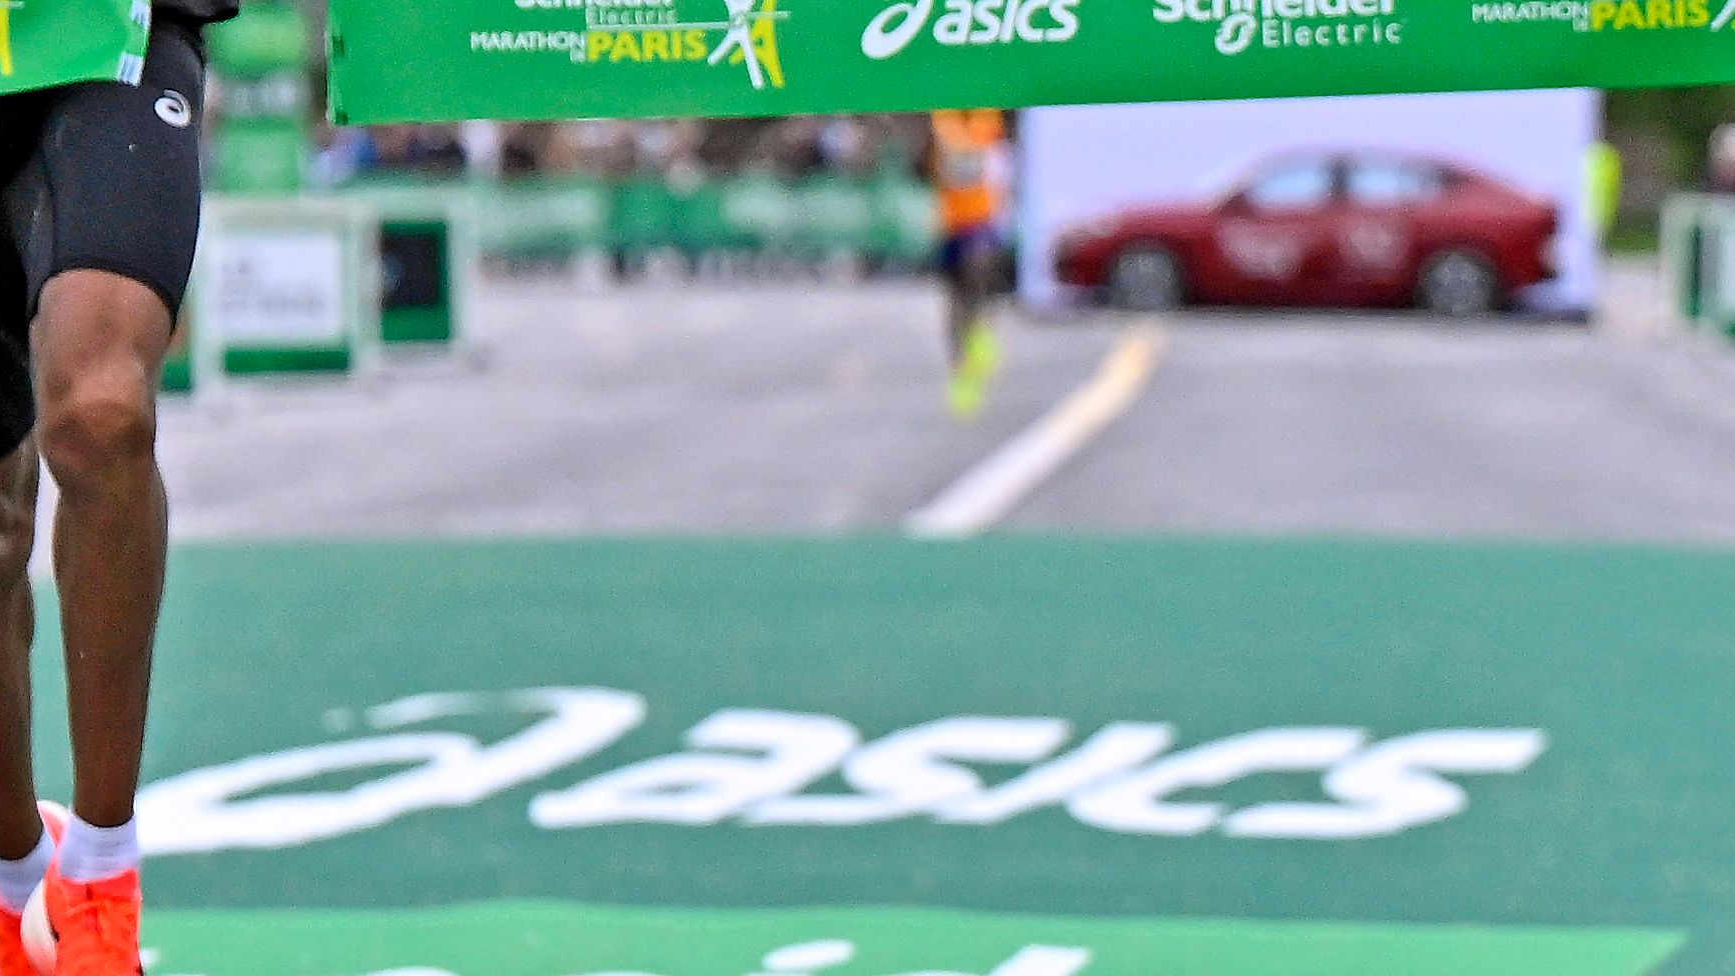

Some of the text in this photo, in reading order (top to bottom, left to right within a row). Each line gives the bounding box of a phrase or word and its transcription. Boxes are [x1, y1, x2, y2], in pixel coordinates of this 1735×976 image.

[1471, 1, 1588, 23] MARATHON
[470, 30, 585, 51] MARATHON
[586, 31, 707, 62] PARIS
[1262, 19, 1403, 48] Electric
